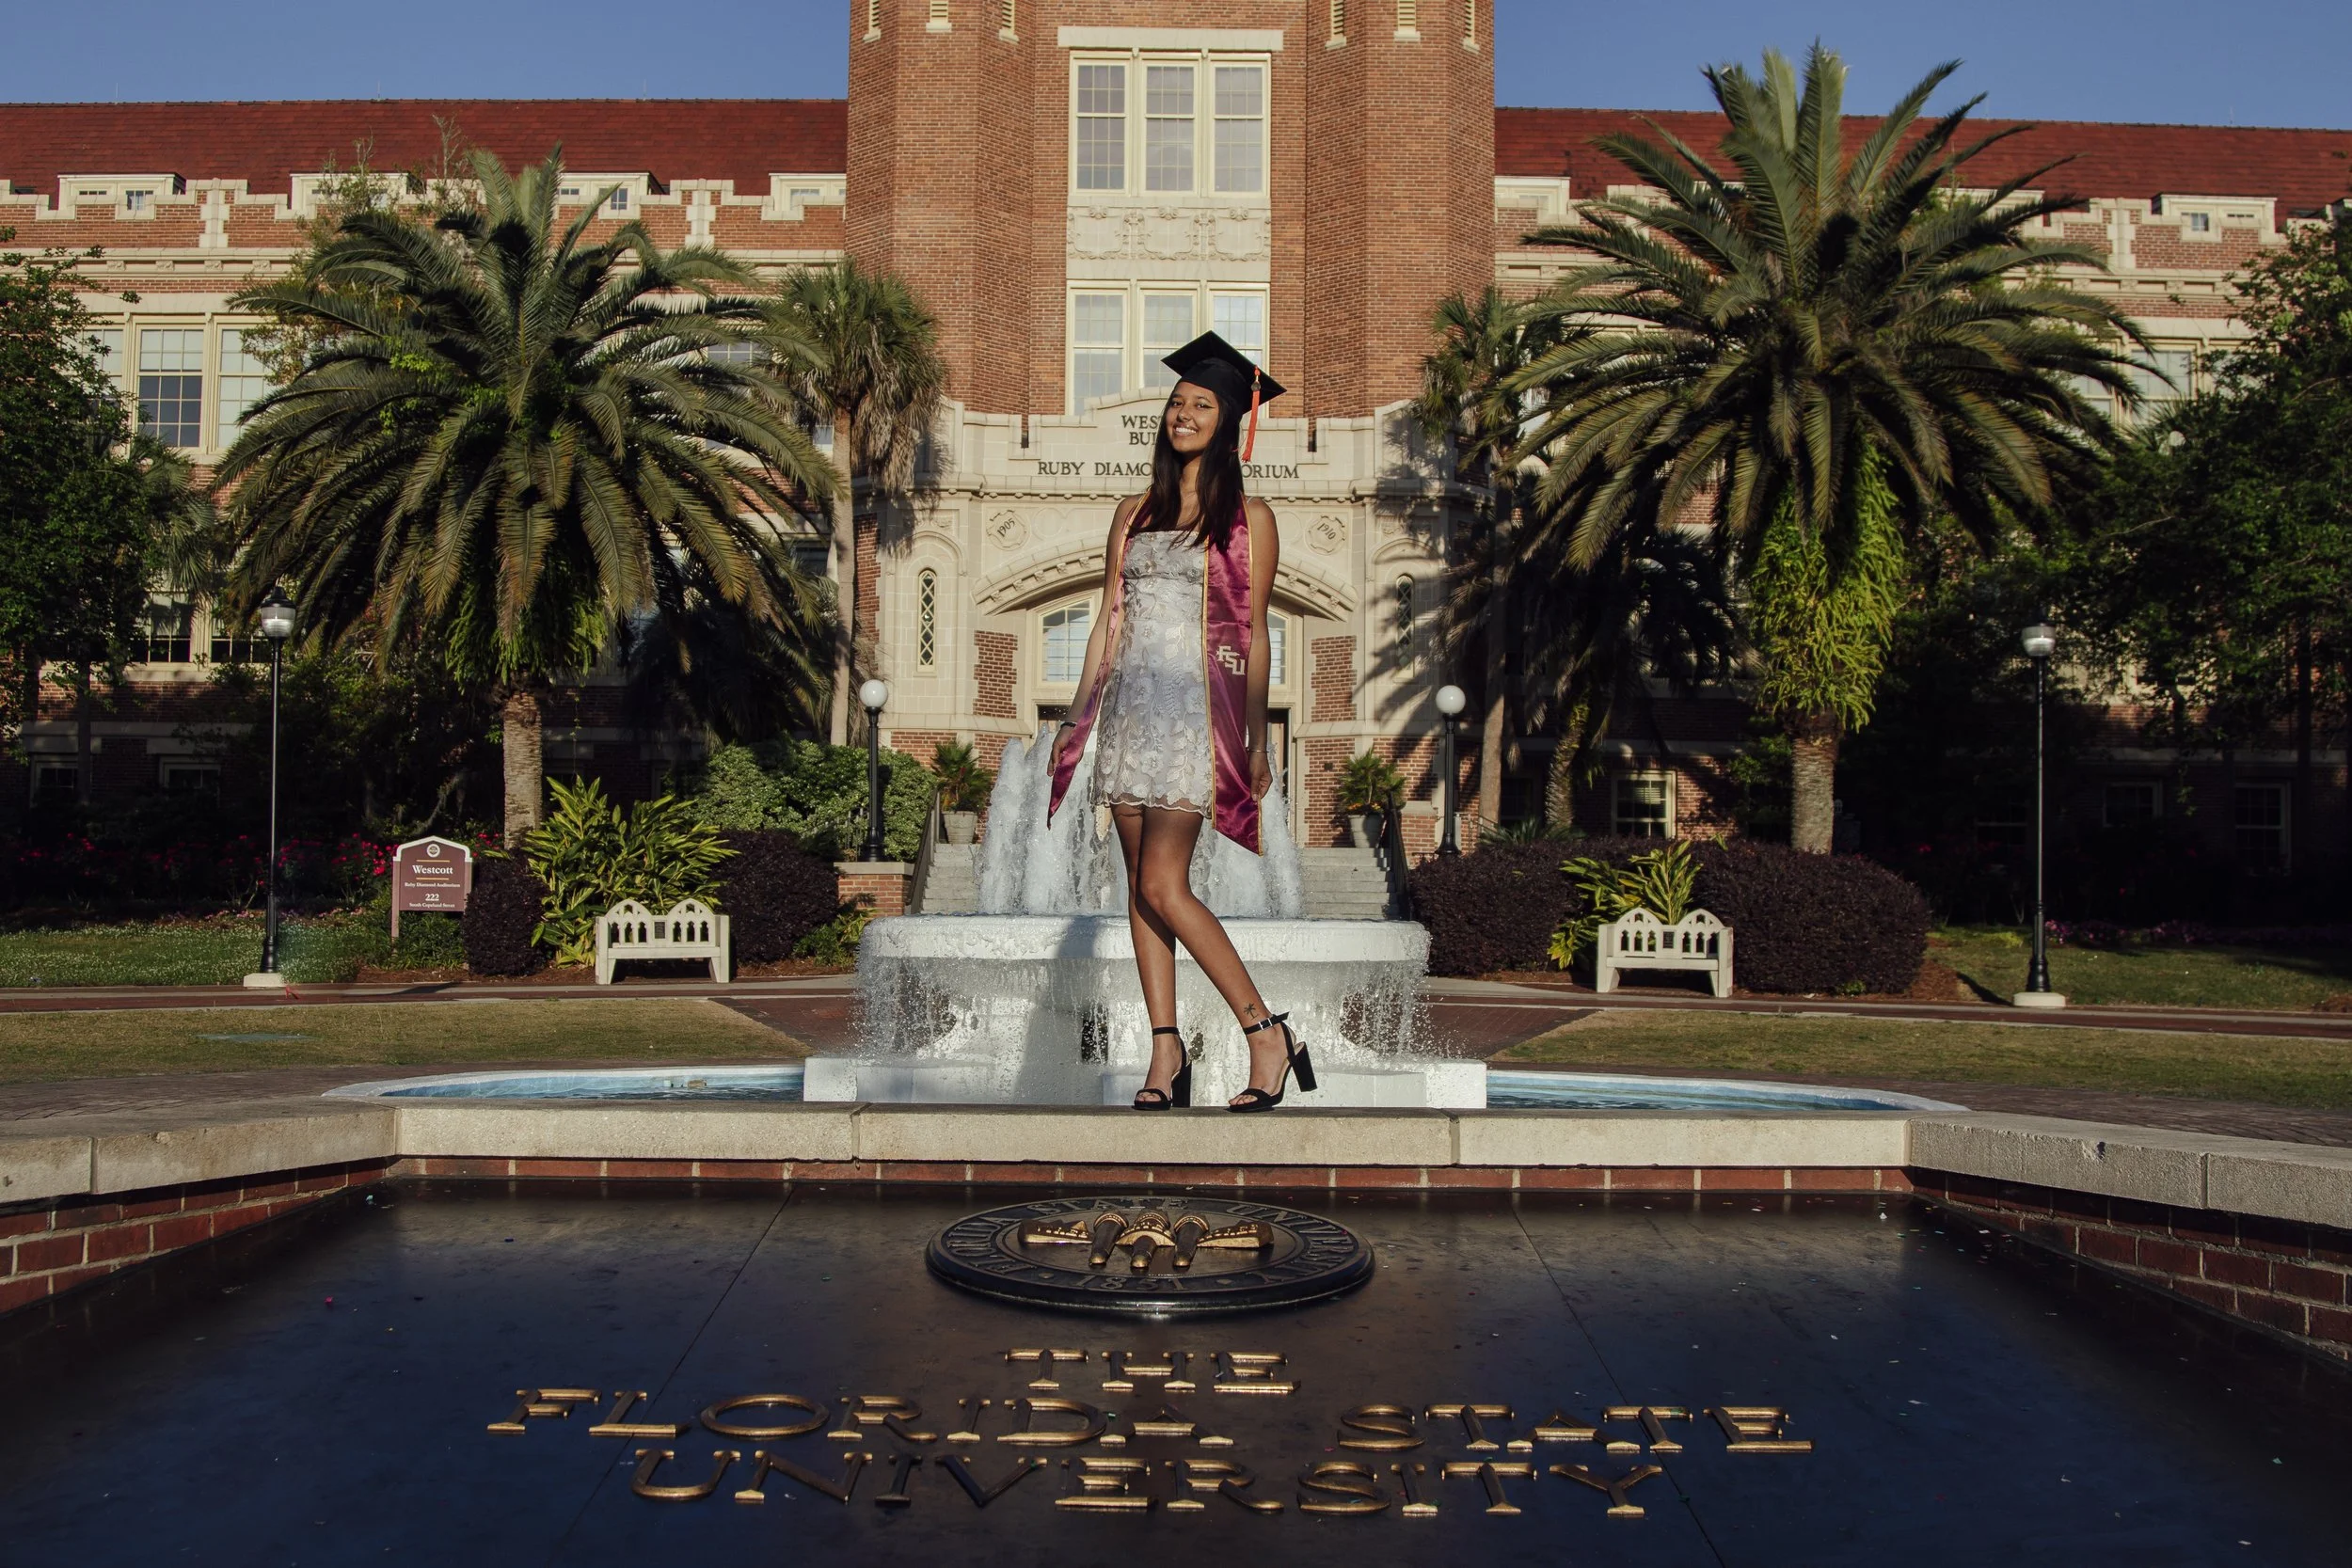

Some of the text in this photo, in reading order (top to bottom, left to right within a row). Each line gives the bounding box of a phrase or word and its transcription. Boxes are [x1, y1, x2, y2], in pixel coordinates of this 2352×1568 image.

[1121, 415, 1162, 429] WES
[1129, 432, 1157, 446] BUI
[1038, 462, 1299, 479] RUBY DIAMO ORIUM
[997, 517, 1016, 537] 1905
[1317, 523, 1336, 540] 1910
[1216, 645, 1246, 675] FSU
[412, 864, 453, 875] Westcott
[425, 893, 439, 901] 222
[1026, 1196, 1189, 1215] STATE
[1076, 1275, 1189, 1291] 1851
[1005, 1348, 1295, 1393] THE
[486, 1388, 1814, 1454] FLORIDA STATE
[630, 1449, 1662, 1517] UNIVERSITY
